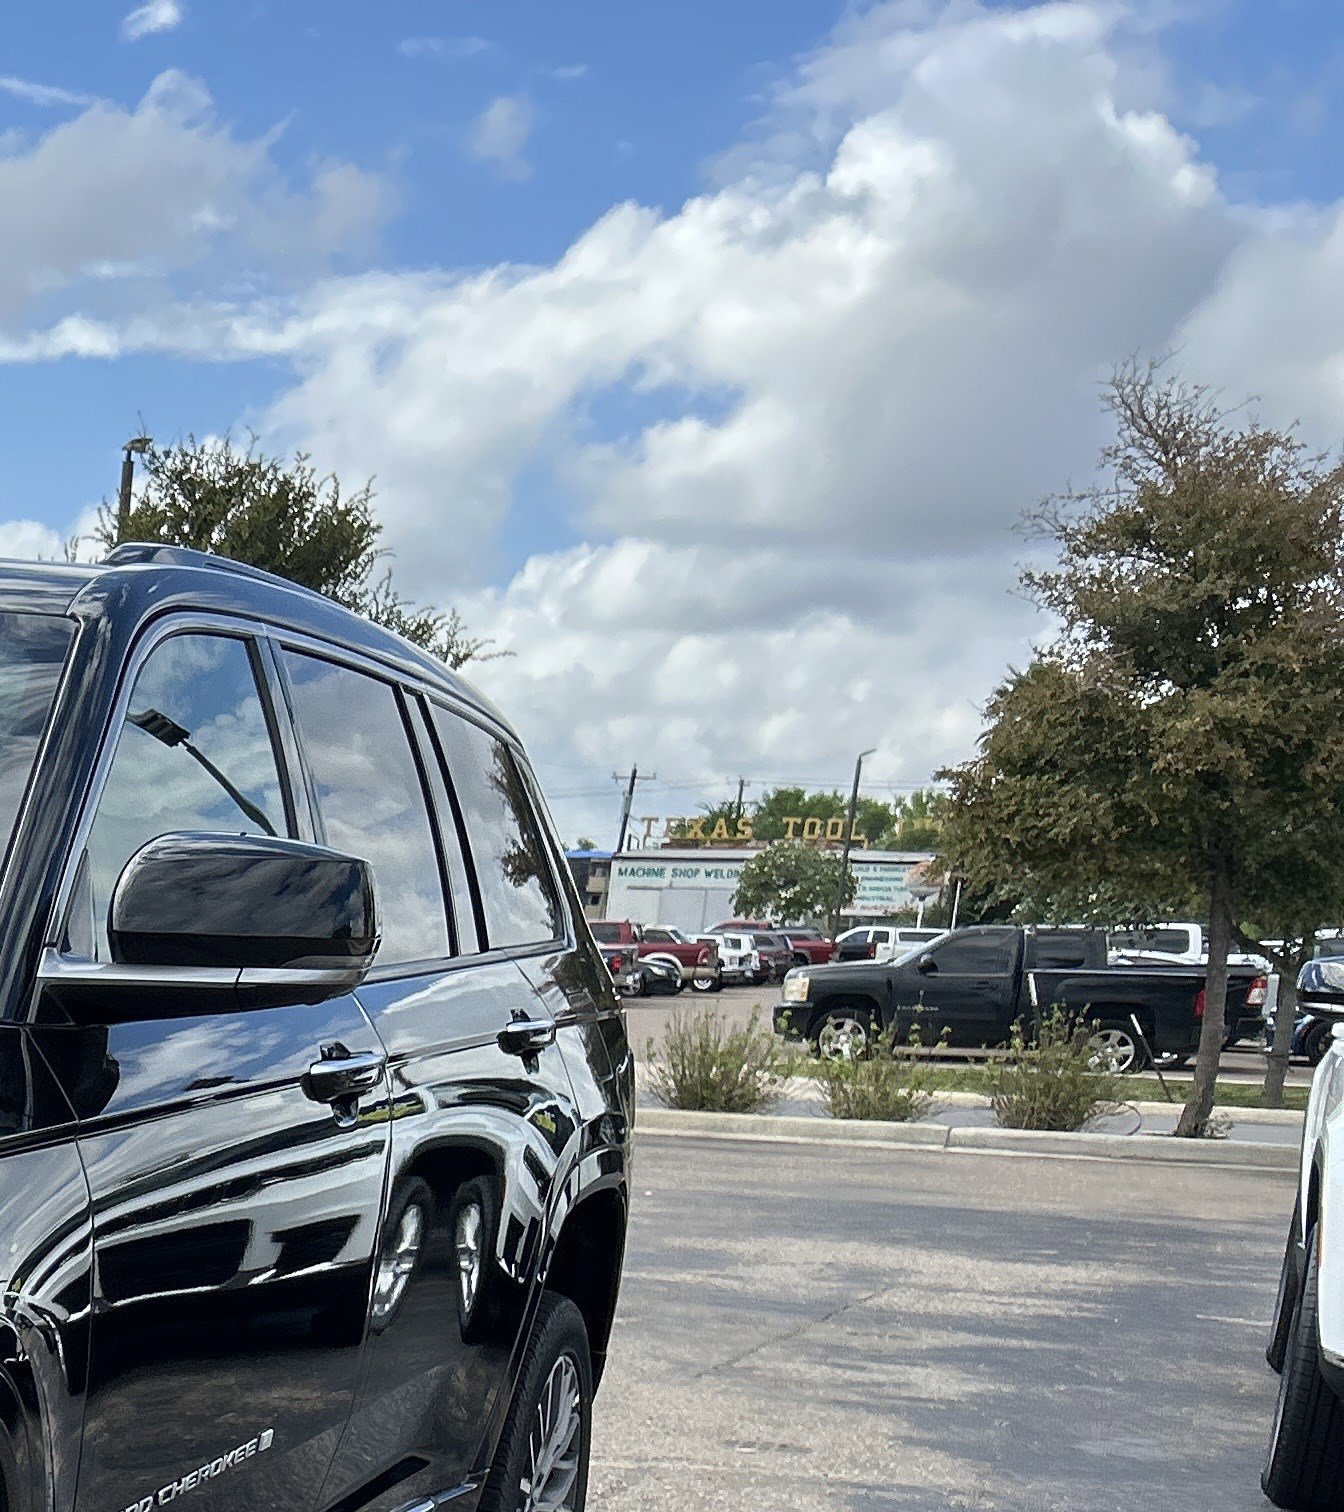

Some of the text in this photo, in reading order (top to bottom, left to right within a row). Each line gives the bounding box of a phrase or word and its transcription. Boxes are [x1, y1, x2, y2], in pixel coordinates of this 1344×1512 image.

[641, 816, 754, 840] TEXAS
[782, 816, 865, 841] TOOL
[618, 867, 666, 879] MACHINE
[671, 867, 700, 879] SHOP
[157, 1437, 258, 1507] CHEROKEE
